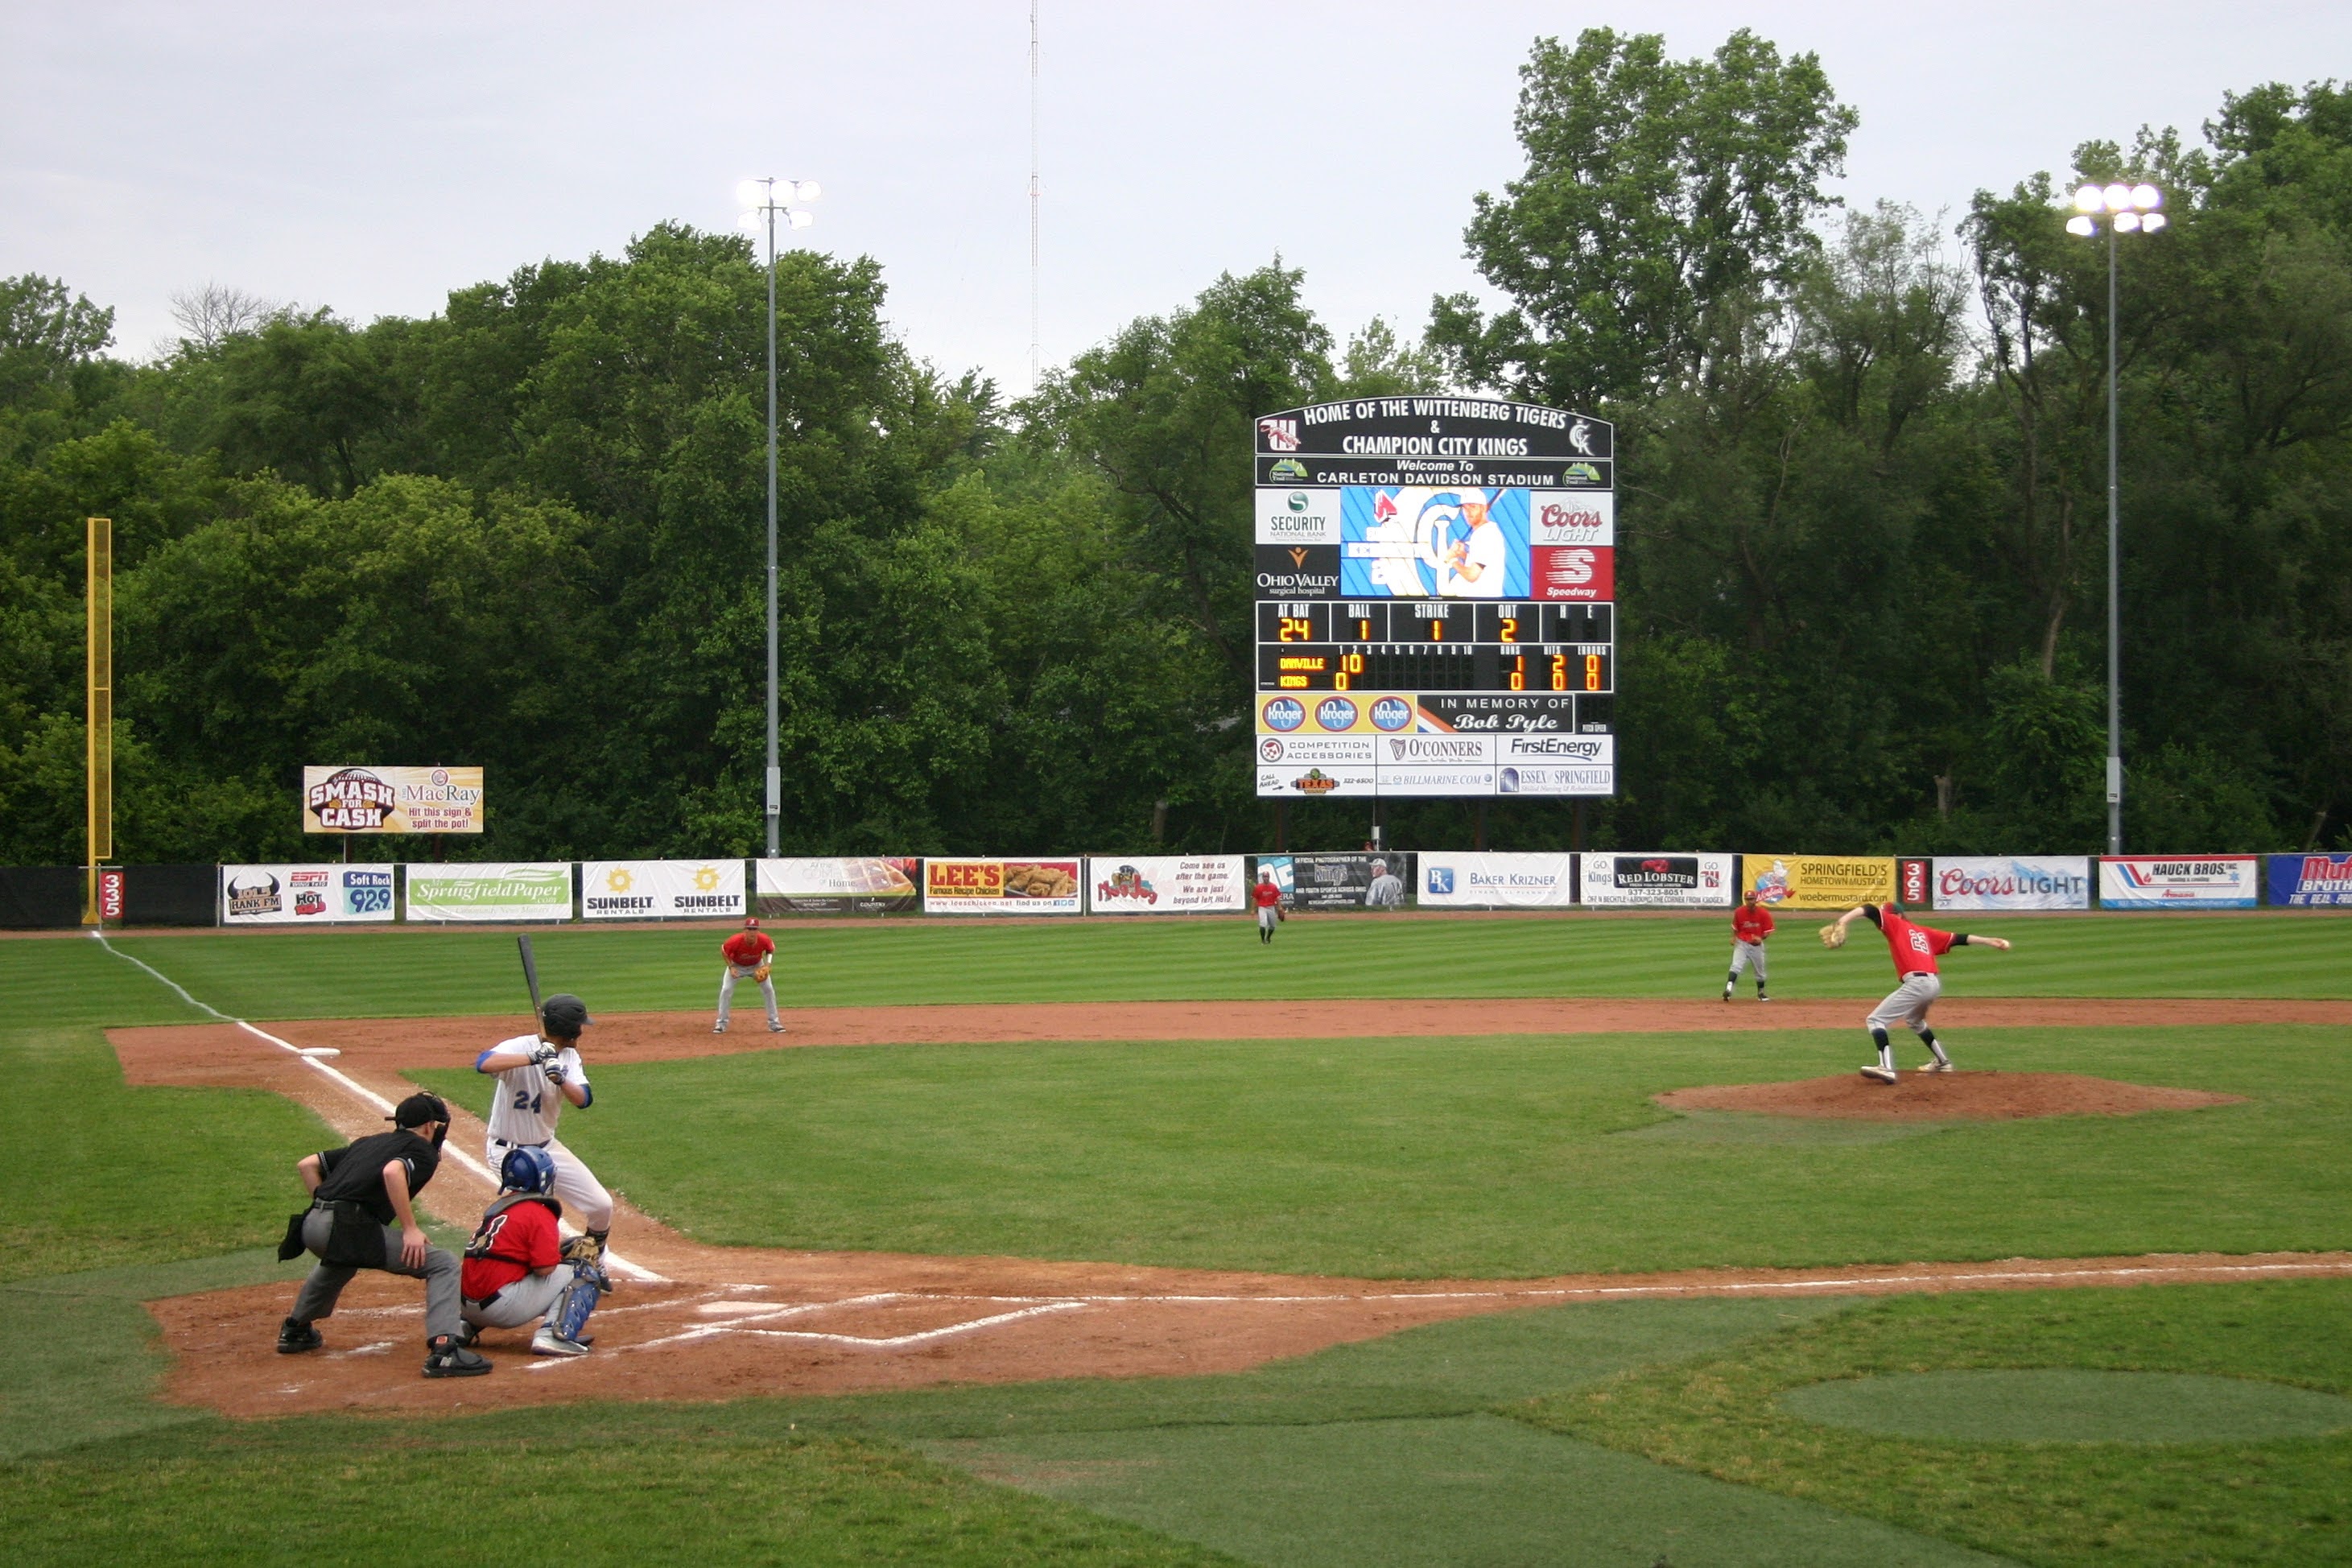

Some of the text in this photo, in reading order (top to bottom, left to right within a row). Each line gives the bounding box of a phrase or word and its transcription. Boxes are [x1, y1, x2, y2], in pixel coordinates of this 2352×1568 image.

[1303, 399, 1567, 430] HOME OF THE WITTENBERG TIGERS
[1430, 420, 1440, 433] &
[1342, 435, 1528, 456] CHAMPION CITY KINGS
[1397, 460, 1474, 472] Welcome To
[1317, 472, 1554, 485] CARLETON DAVIDSON STADIUM
[1540, 504, 1603, 527] Coors
[1271, 516, 1326, 531] SECURITY
[1543, 528, 1599, 542] LIGHT
[1269, 587, 1325, 596] surgical hospital
[1546, 587, 1597, 597] Speedway
[1277, 604, 1310, 617] AT BAT
[1348, 604, 1371, 618] BALL
[1414, 605, 1449, 618] STRIKE
[1498, 605, 1517, 618] OUT
[1560, 605, 1566, 619] H
[1587, 605, 1592, 619] E
[1279, 618, 1310, 642] 24
[1360, 620, 1368, 641] 1
[1433, 620, 1440, 641] 1
[1500, 618, 1516, 642] 2
[1339, 645, 1343, 654] 1
[1352, 645, 1358, 654] 2
[1366, 645, 1372, 654] 3
[1380, 645, 1386, 654] 4
[1394, 645, 1400, 654] 5
[1409, 645, 1414, 654] 6
[1423, 645, 1428, 654] 7
[1463, 645, 1472, 654] 10
[1500, 646, 1521, 655] RUNS
[1543, 646, 1561, 655] HITS
[1280, 654, 1598, 672] DANVILLE 1 2 0
[1280, 672, 1598, 691] KINGS 0 0 0 0
[1441, 698, 1569, 708] IN MEMORY OF
[1268, 701, 1302, 727] Kroger
[1320, 701, 1355, 727] Kroger
[1374, 701, 1409, 727] Kroger
[1452, 714, 1558, 732] Bob Pyle
[1409, 738, 1483, 757] O'CONNERS
[1511, 738, 1603, 757] FirstEnergy
[1259, 779, 1279, 788] AHEAD
[1403, 774, 1481, 785] BILLMARINE.COM
[1521, 770, 1610, 784] ESSEX SPRINGFIELD
[1298, 779, 1334, 789] TEXAS
[311, 781, 394, 807] SMASH
[406, 785, 481, 805] MacRay
[341, 798, 362, 808] FOR
[323, 808, 382, 826] CASH
[409, 807, 472, 818] Hit this sign &
[412, 819, 468, 829] split the pot!
[1179, 862, 1200, 870] Come
[1704, 862, 1719, 870] GO
[1801, 863, 1887, 876] SPRINGFIELD'S
[2152, 863, 2226, 876] HAUCK BROS.
[291, 872, 328, 881] ESPN
[350, 873, 390, 885] Soft Rock
[930, 864, 1000, 886] LEE'S
[1175, 872, 1229, 881] after the game.
[1470, 873, 1556, 885] BAKER KRIZNER
[1588, 870, 1612, 885] Kings
[1617, 871, 1694, 885] RED LOBSTER
[1800, 877, 1887, 885] HOMETOWN MUSTARD
[1938, 868, 2082, 895] Coors LIGHT
[1906, 863, 1921, 901] 365
[105, 874, 120, 916] 335
[929, 886, 1000, 896] Famous Recipe Chicken
[1182, 885, 1195, 893] We
[1210, 885, 1224, 893] just
[2161, 889, 2196, 897] Amana
[232, 897, 279, 910] HANK FM
[296, 893, 322, 905] HOT
[587, 896, 654, 909] SUNBELT
[675, 895, 741, 907] SUNBELT
[1173, 896, 1199, 904] beyond
[1799, 892, 1888, 902] woebermustard.com
[2289, 893, 2332, 904] THE REAL
[513, 1091, 542, 1114] 24
